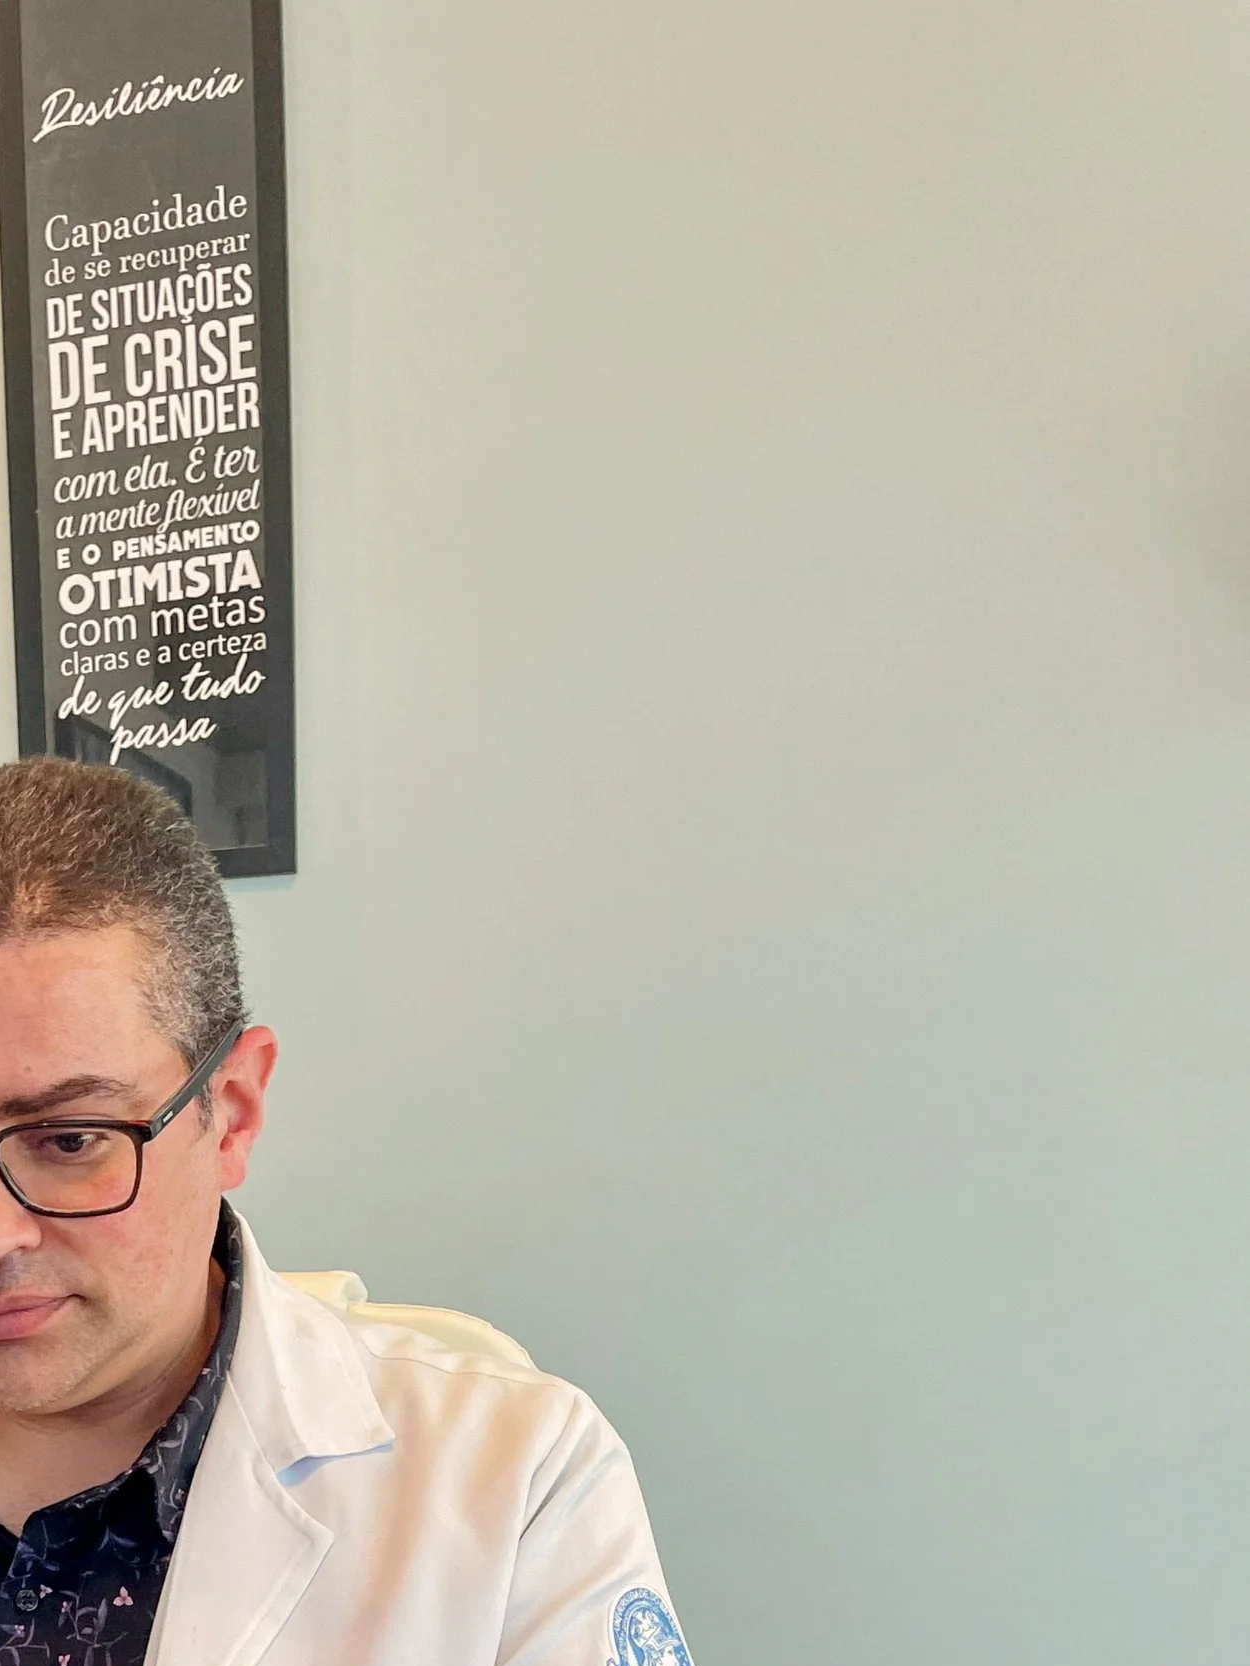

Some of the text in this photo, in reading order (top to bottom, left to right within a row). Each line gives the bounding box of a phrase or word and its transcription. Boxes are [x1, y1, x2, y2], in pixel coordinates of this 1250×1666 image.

[32, 67, 244, 143] Resiliência
[44, 185, 248, 256] Capacidade
[44, 231, 251, 287] de se recuperar
[46, 262, 252, 339] DE SITUAÇÕES
[49, 314, 256, 410] DE CRISE
[52, 381, 260, 460] E APRENDER
[54, 436, 259, 503] com ela. É ter
[55, 479, 261, 539] a mente flexível
[56, 519, 260, 570] E O PENSAMENTO
[59, 549, 263, 615] OTIMISTA
[59, 594, 266, 649] com metas
[61, 632, 267, 676] claras e a certeza
[58, 653, 267, 729] de que tudo
[110, 714, 217, 766] passa
